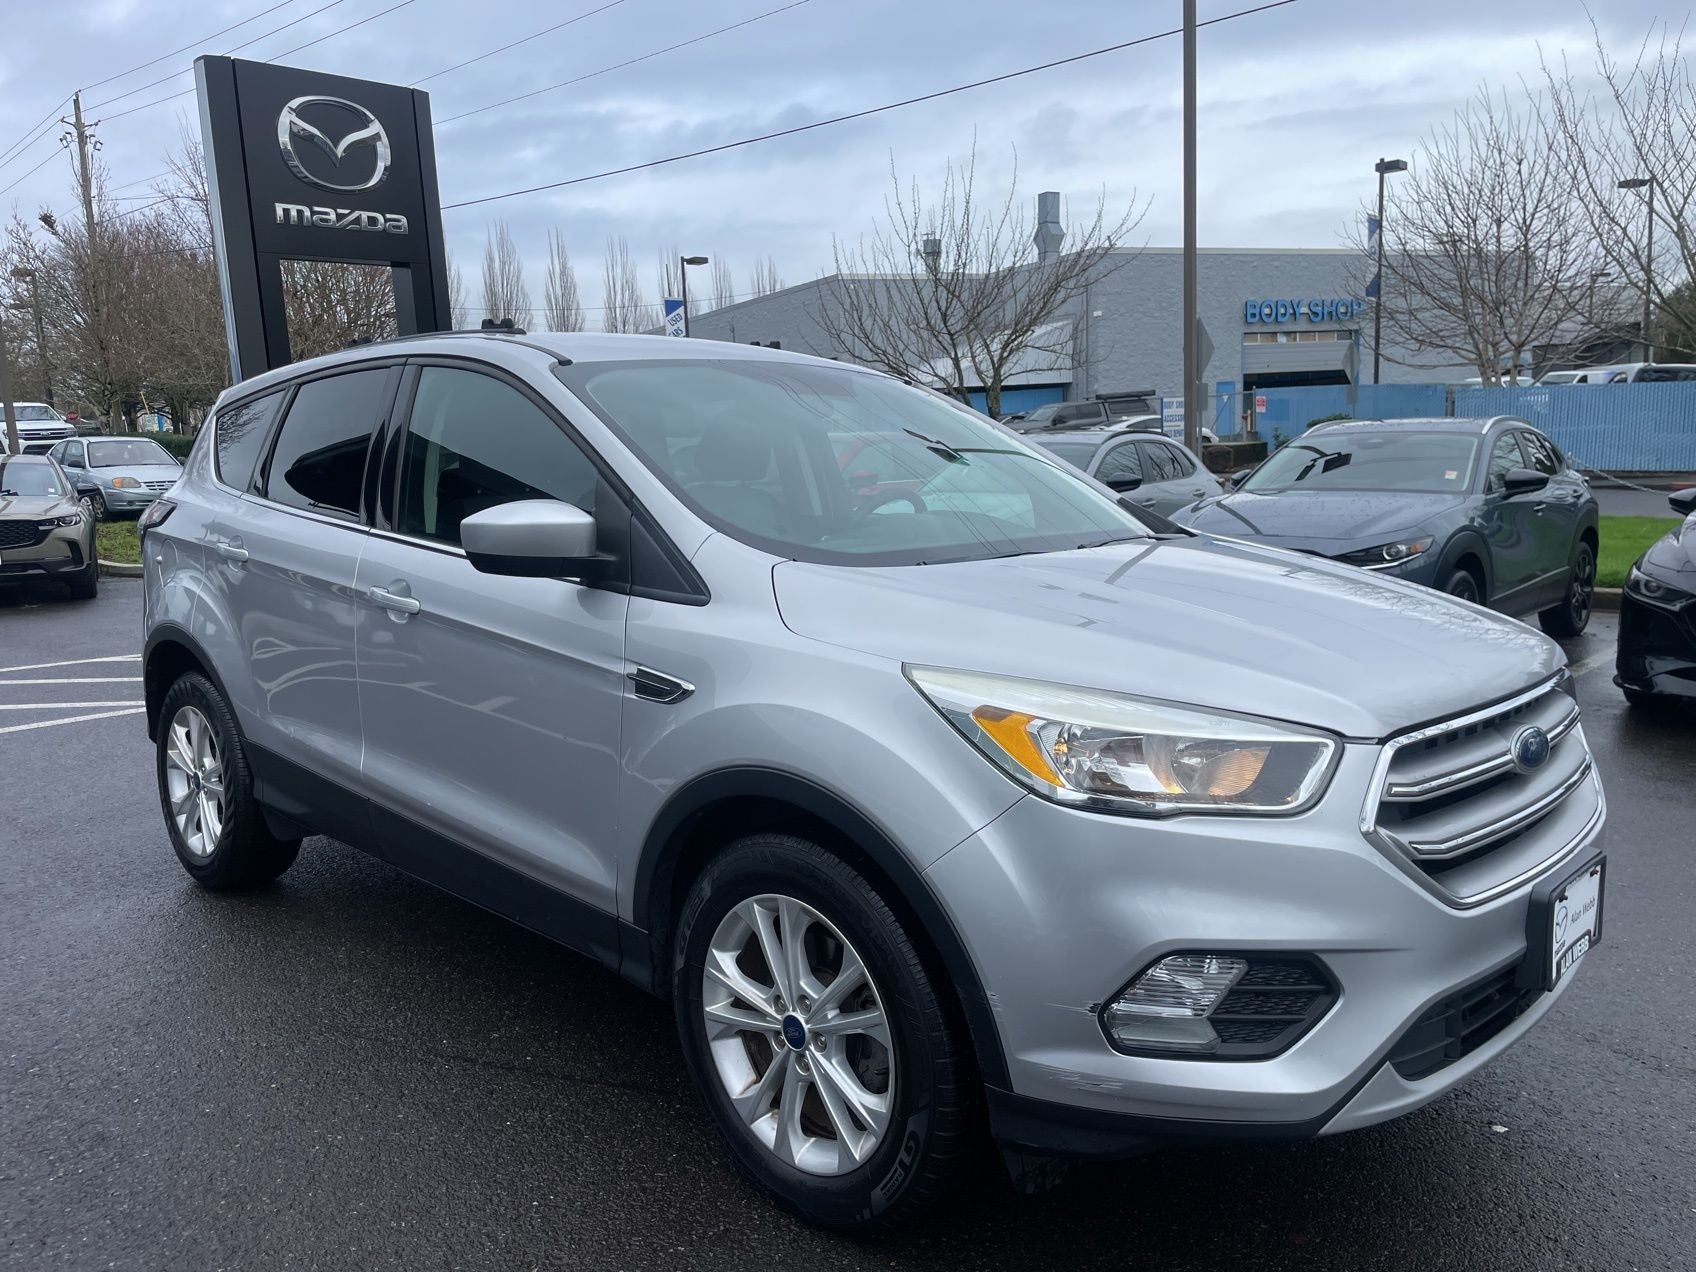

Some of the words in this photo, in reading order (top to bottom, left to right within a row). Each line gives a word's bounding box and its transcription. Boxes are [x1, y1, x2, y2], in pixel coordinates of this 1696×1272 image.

[668, 313, 683, 326] USED
[1245, 299, 1303, 323] BODY
[1308, 299, 1365, 322] SHOP
[1163, 414, 1184, 422] ACCESSO
[1573, 935, 1590, 961] WEBB
